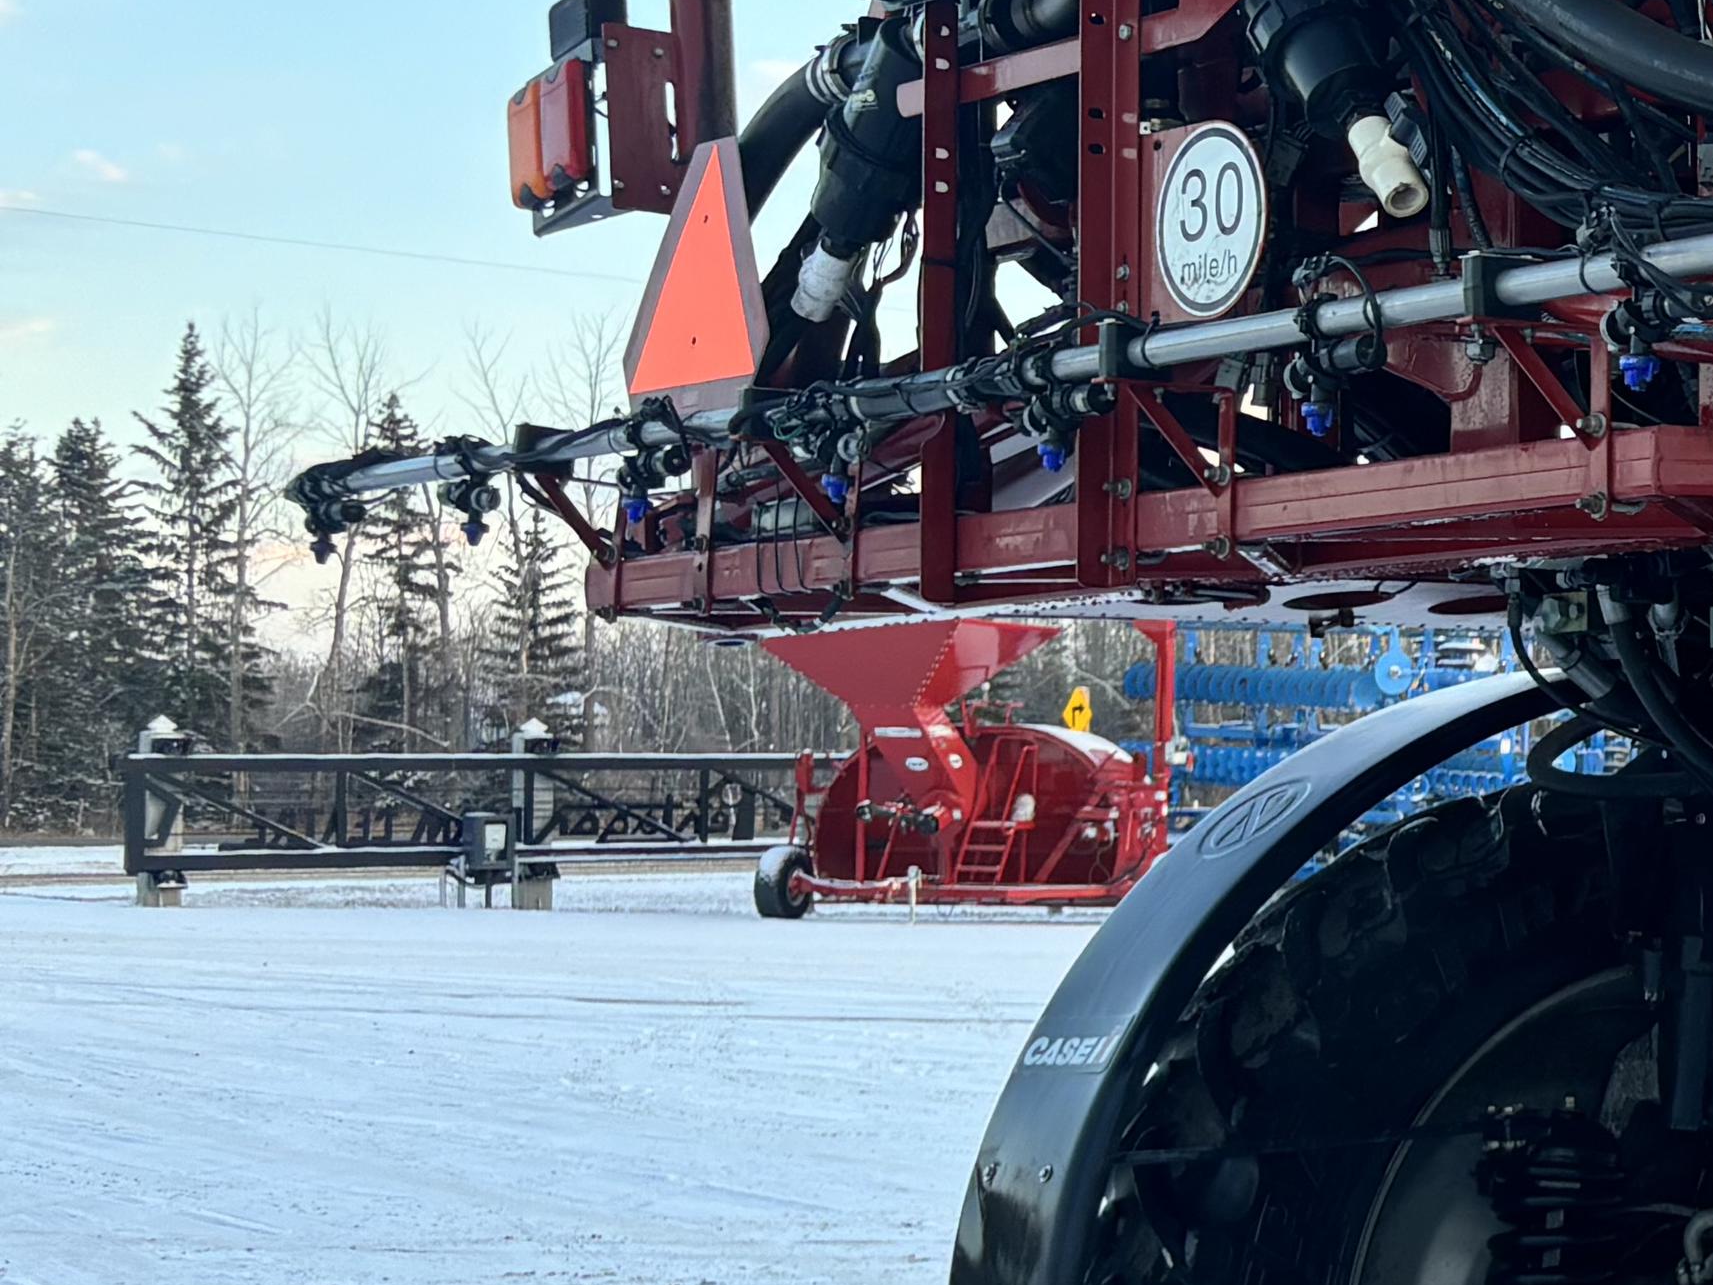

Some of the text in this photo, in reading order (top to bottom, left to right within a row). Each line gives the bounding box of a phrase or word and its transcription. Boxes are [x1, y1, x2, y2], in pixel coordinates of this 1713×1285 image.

[1180, 161, 1244, 243] 30
[1181, 248, 1238, 284] mile/h
[1023, 1035, 1100, 1066] CASE
